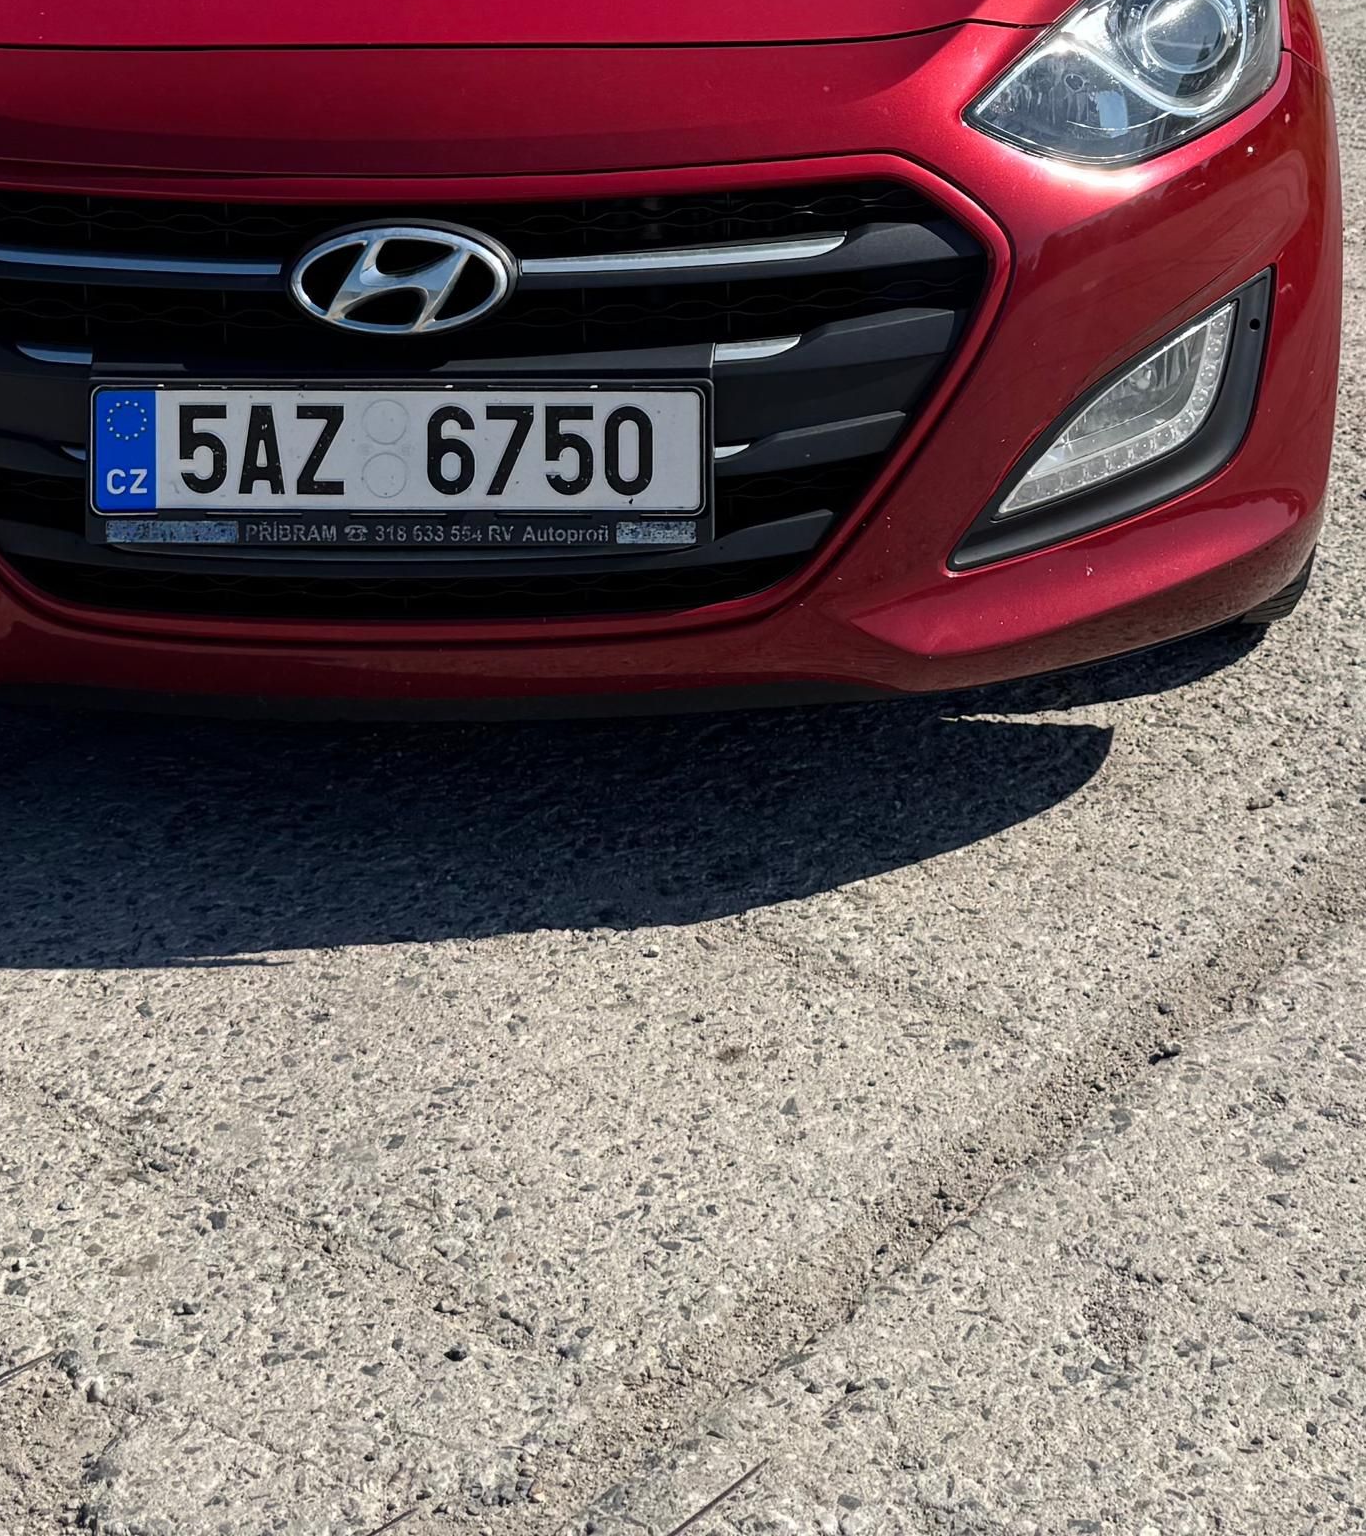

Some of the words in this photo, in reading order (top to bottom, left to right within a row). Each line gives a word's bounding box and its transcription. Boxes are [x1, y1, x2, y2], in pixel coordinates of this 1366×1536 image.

[177, 403, 346, 496] 5AZ
[426, 404, 655, 497] 6750
[105, 468, 148, 495] CZ
[244, 521, 338, 542] PŘÍBRAM
[374, 525, 408, 542] 318
[488, 524, 515, 542] RV
[522, 525, 609, 544] Autoprofi
